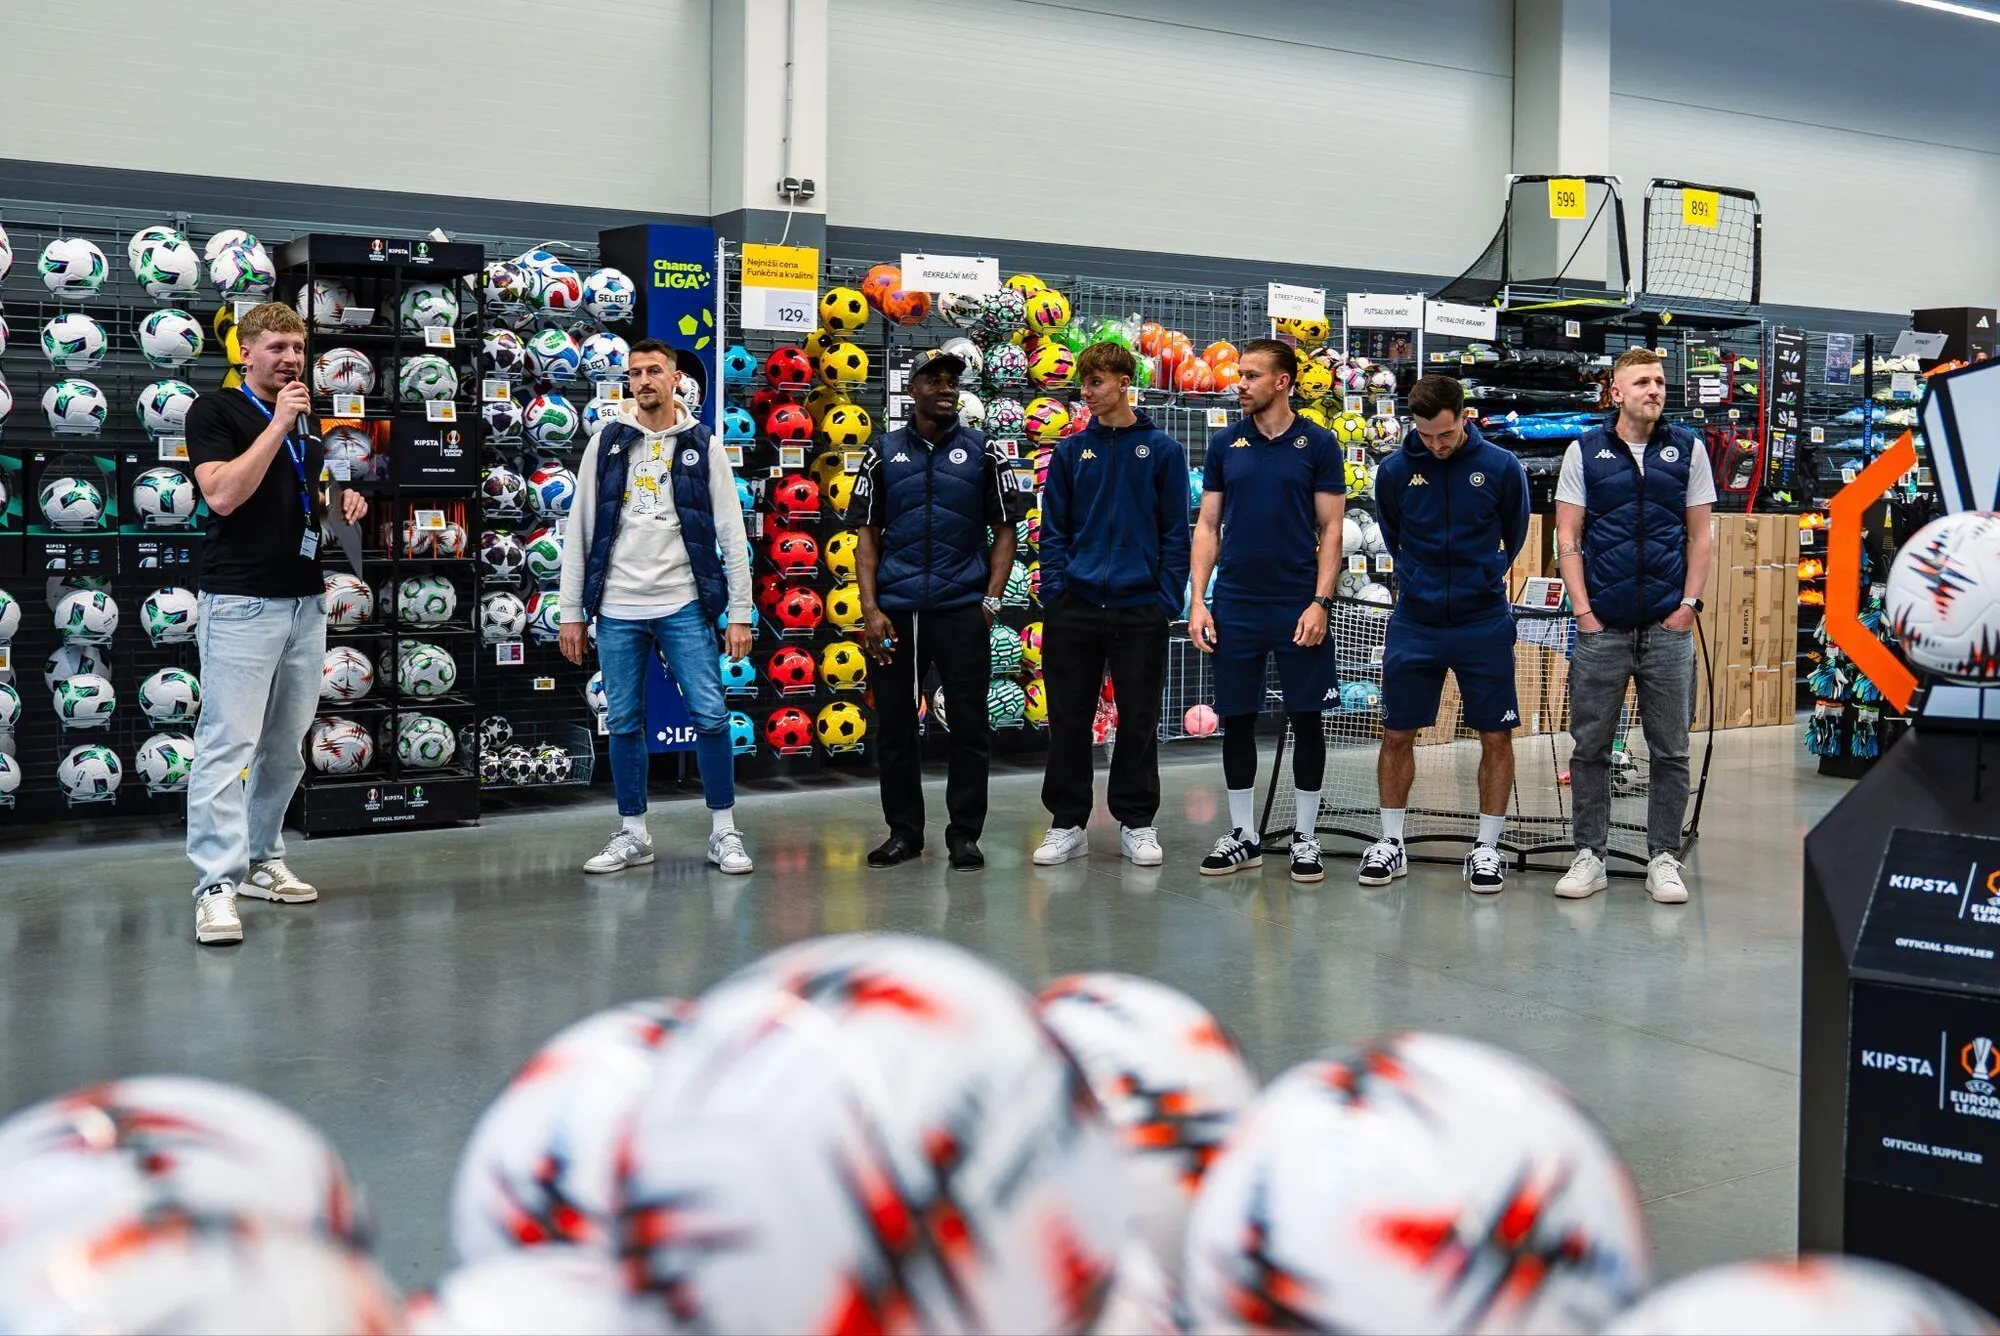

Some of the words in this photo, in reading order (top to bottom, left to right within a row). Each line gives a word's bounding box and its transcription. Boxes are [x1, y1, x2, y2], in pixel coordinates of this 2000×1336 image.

[1557, 191, 1575, 207] 599
[653, 259, 702, 272] Chance
[654, 272, 700, 289] LIGA
[922, 270, 960, 280] REKREAČNÍ
[598, 293, 629, 303] SELECT
[1294, 296, 1320, 304] FOOTBALL
[778, 308, 803, 322] 129
[601, 408, 620, 418] SEL
[1864, 417, 1872, 456] KONTROLA
[1889, 874, 1959, 896] KIPSTA
[1971, 904, 2000, 916] EUR
[1895, 937, 1942, 952] OFFICIAL
[1943, 944, 1995, 960] SUPPLIER
[1861, 1050, 1934, 1077] KIPSTA
[1950, 1090, 2000, 1109] EUROP
[1882, 1137, 1930, 1155] OFFICIAL
[1931, 1146, 1983, 1164] SUPPLIER
